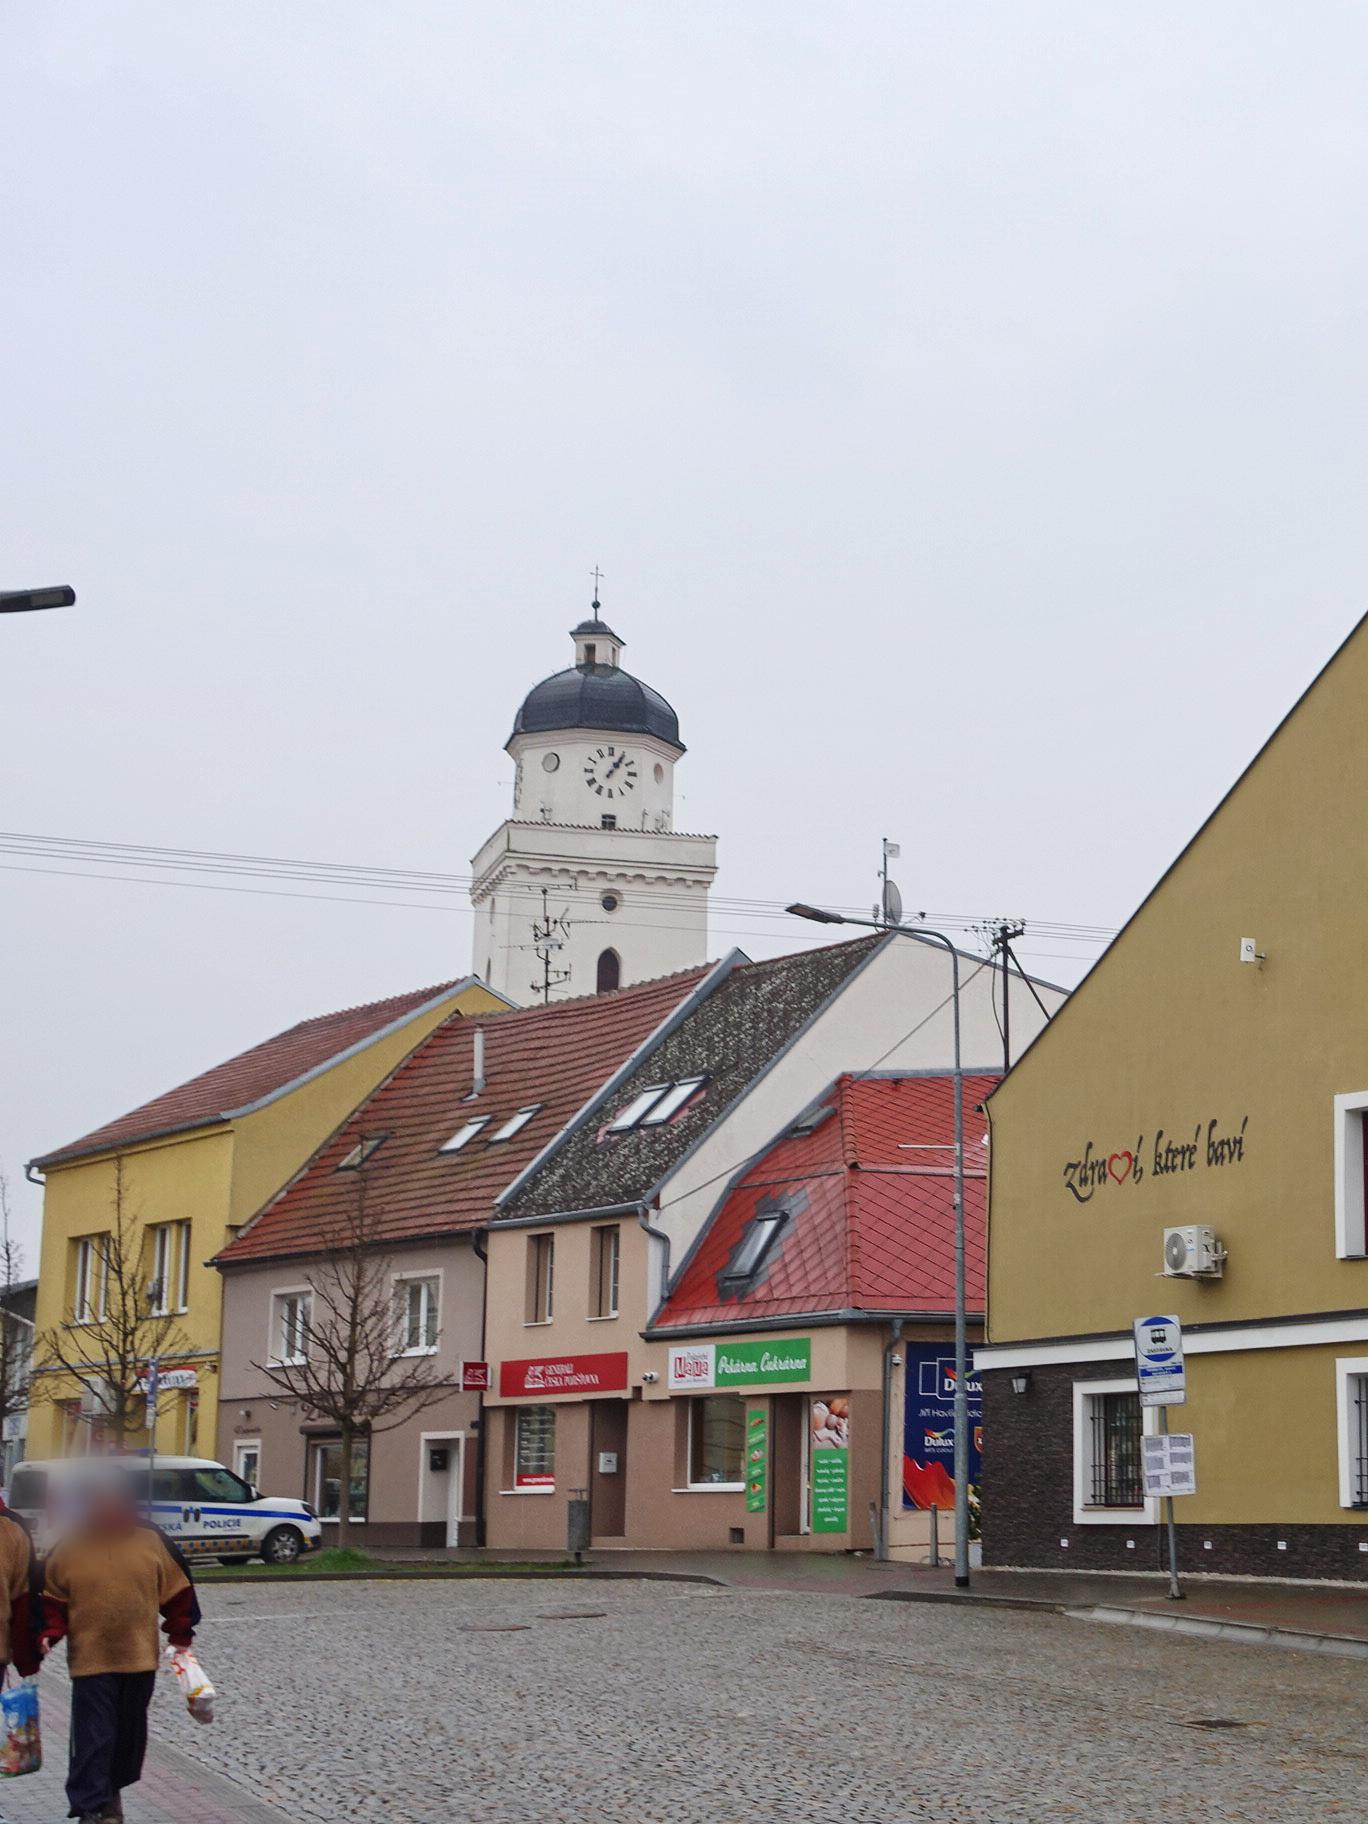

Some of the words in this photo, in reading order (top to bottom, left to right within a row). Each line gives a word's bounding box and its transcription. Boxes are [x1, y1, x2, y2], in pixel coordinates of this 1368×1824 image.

[1152, 1123, 1201, 1176] které
[1206, 1115, 1248, 1167] baví
[944, 1378, 984, 1393] Dux
[924, 1436, 955, 1447] Dulux
[203, 1518, 241, 1530] POLICIE
